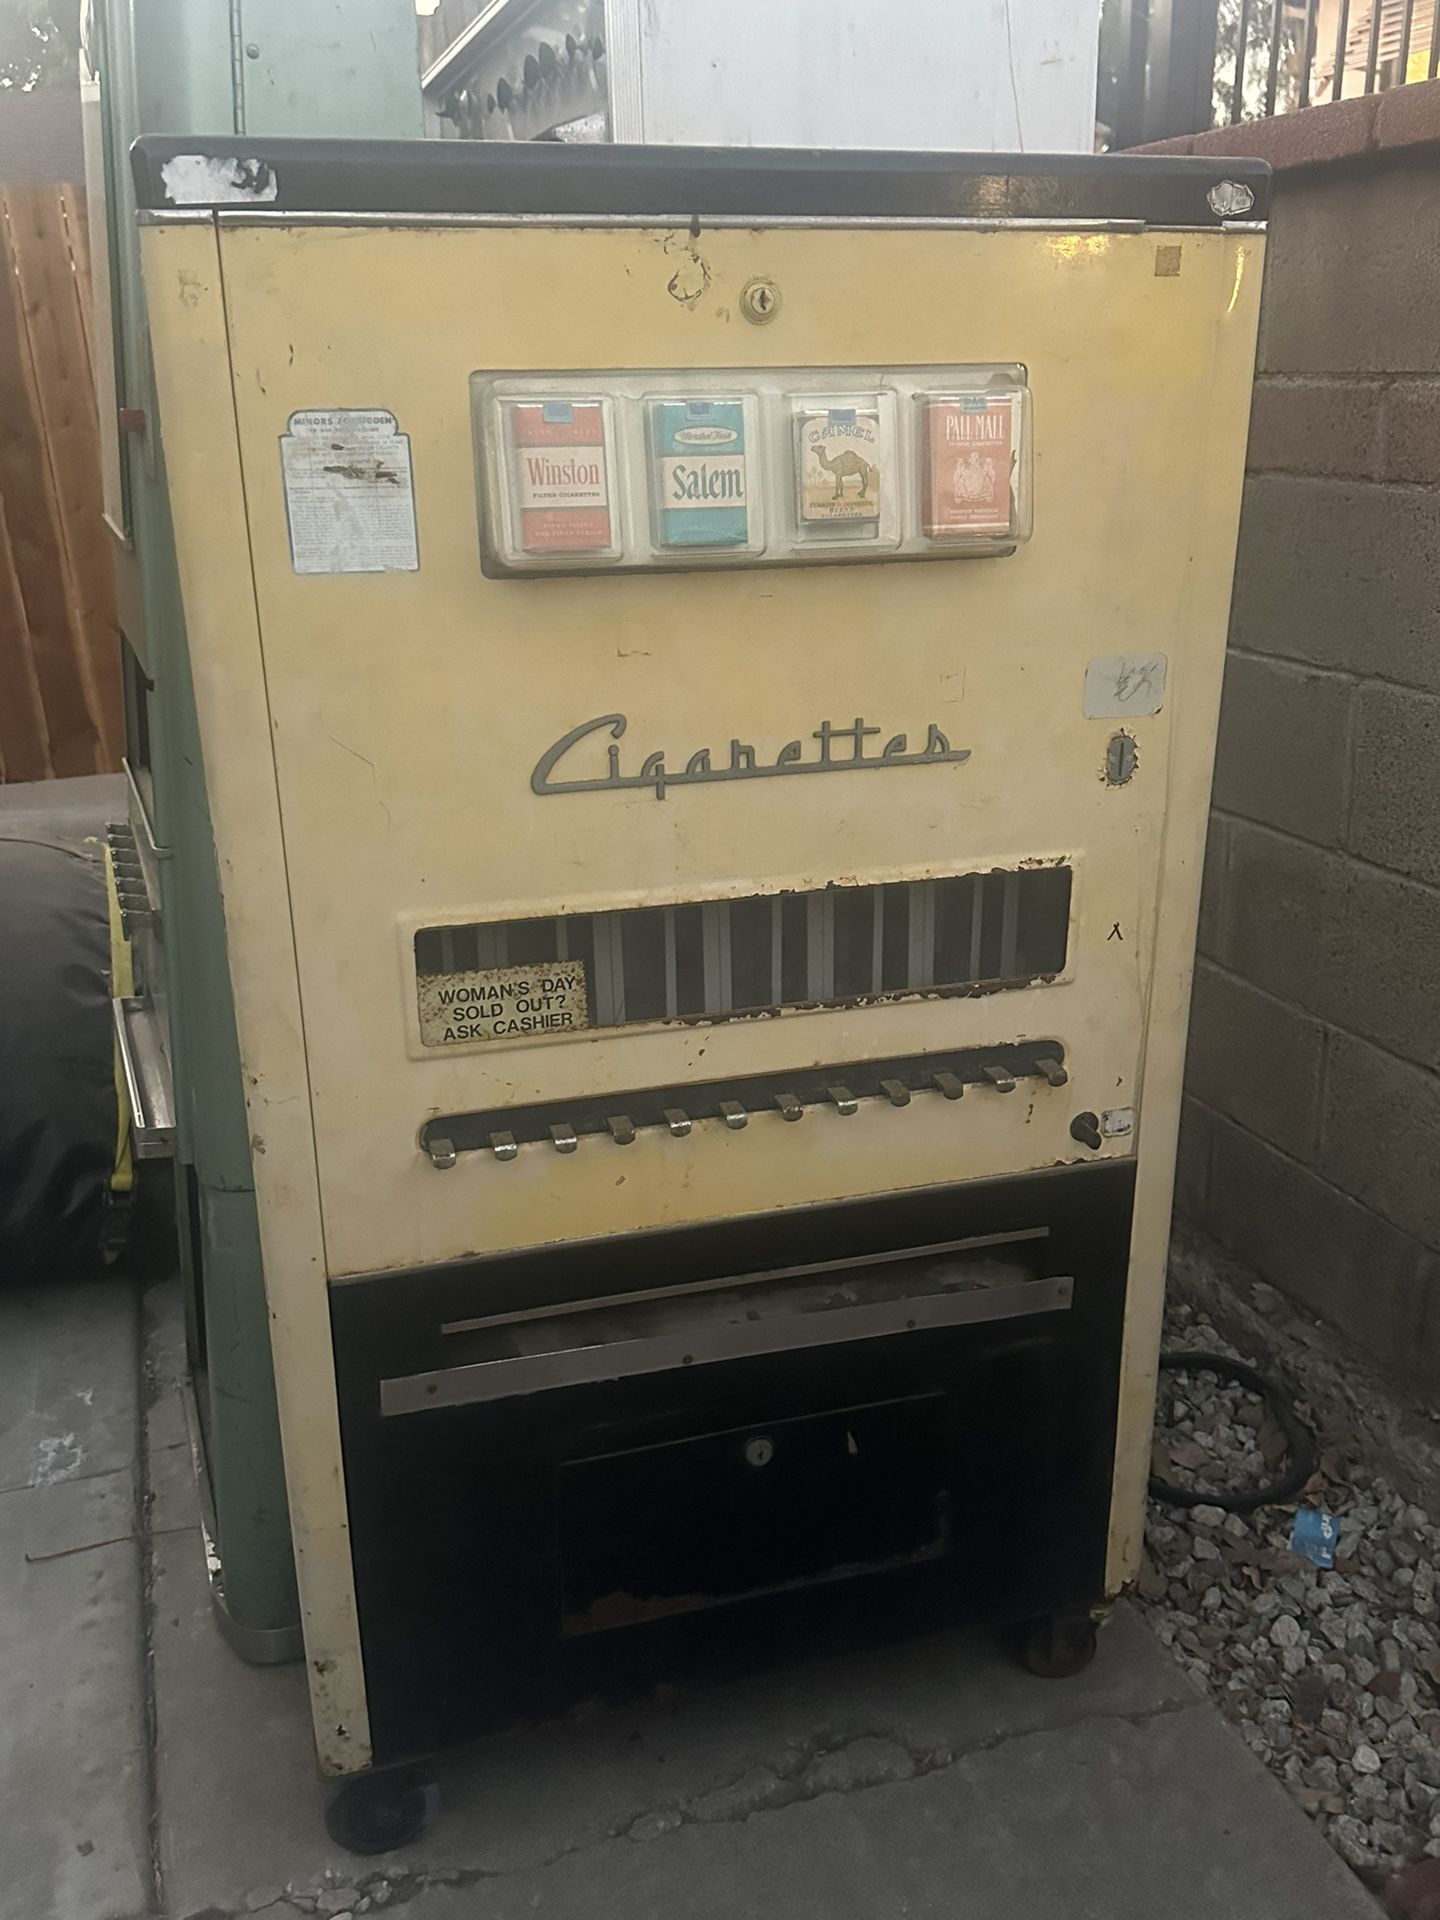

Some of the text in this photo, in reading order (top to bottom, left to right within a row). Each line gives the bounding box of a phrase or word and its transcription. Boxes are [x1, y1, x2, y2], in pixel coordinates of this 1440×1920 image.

[293, 417, 333, 426] MINORS
[808, 424, 876, 444] CAMEL
[946, 414, 1005, 440] PALL MALL
[526, 457, 600, 486] Winston
[672, 463, 744, 500] Salem
[530, 713, 972, 800] Cigarettes
[541, 976, 576, 992] DAY
[453, 995, 566, 1022] SOLD OUT?
[443, 1012, 573, 1041] ASK CASHIER
